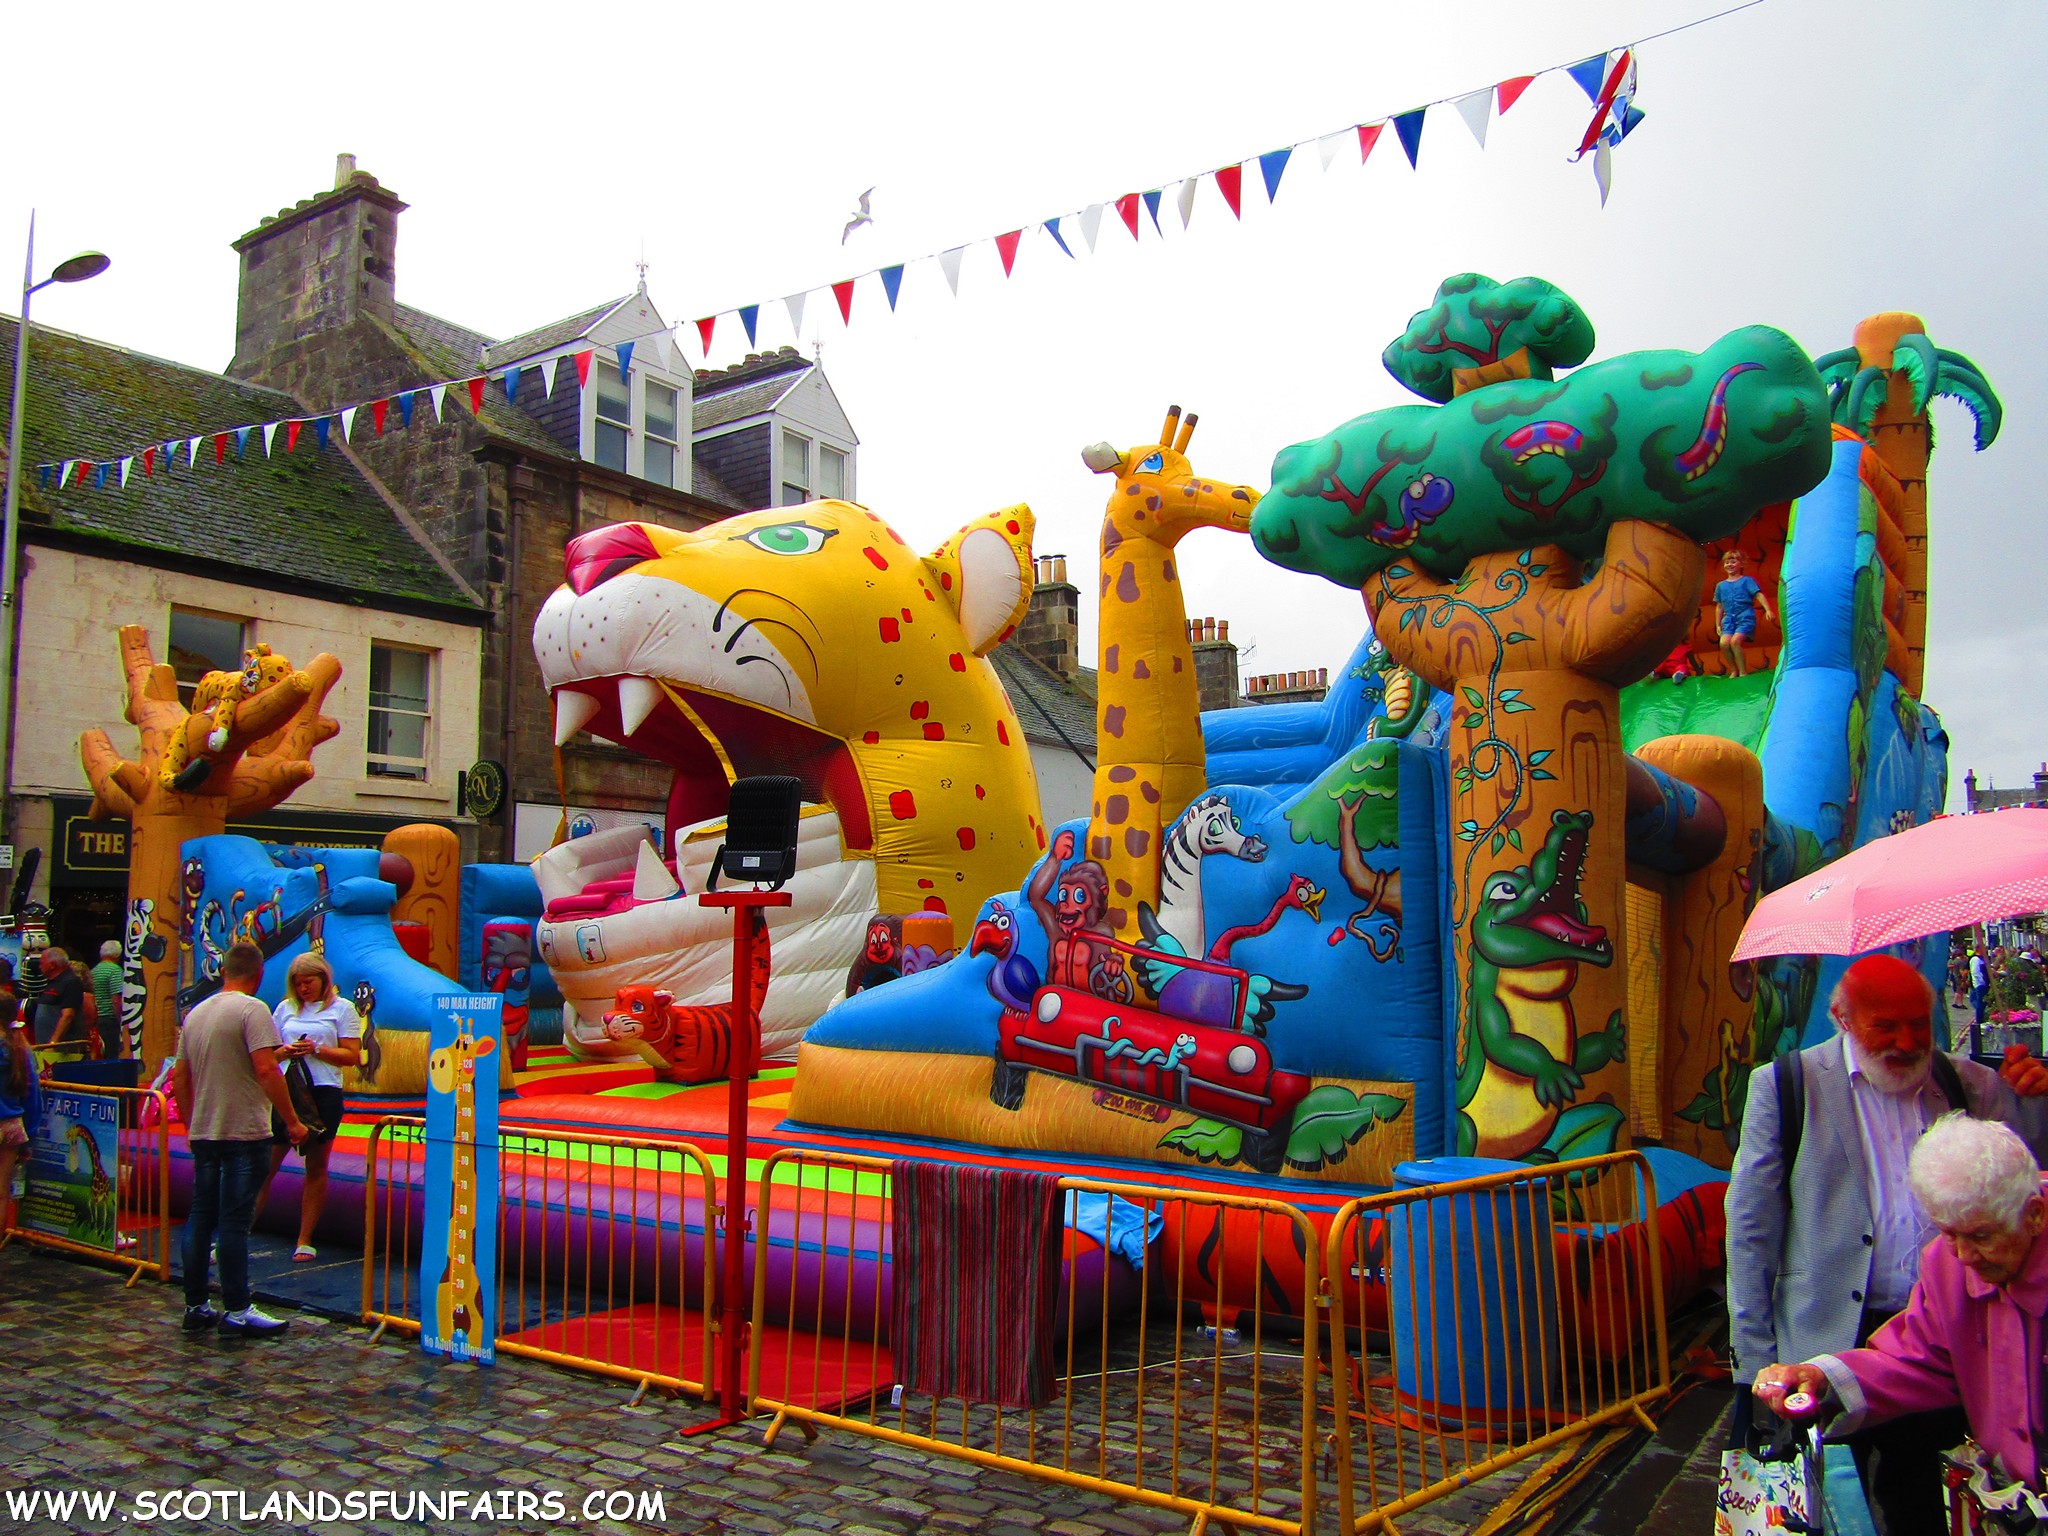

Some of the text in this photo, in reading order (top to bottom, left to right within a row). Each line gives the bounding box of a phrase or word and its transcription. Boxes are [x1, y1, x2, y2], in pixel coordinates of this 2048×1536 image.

[78, 831, 126, 855] THE
[437, 997, 497, 1011] 140 MAX HEIGHT
[90, 1103, 115, 1122] FUN
[424, 1333, 492, 1360] No Adults Allowed
